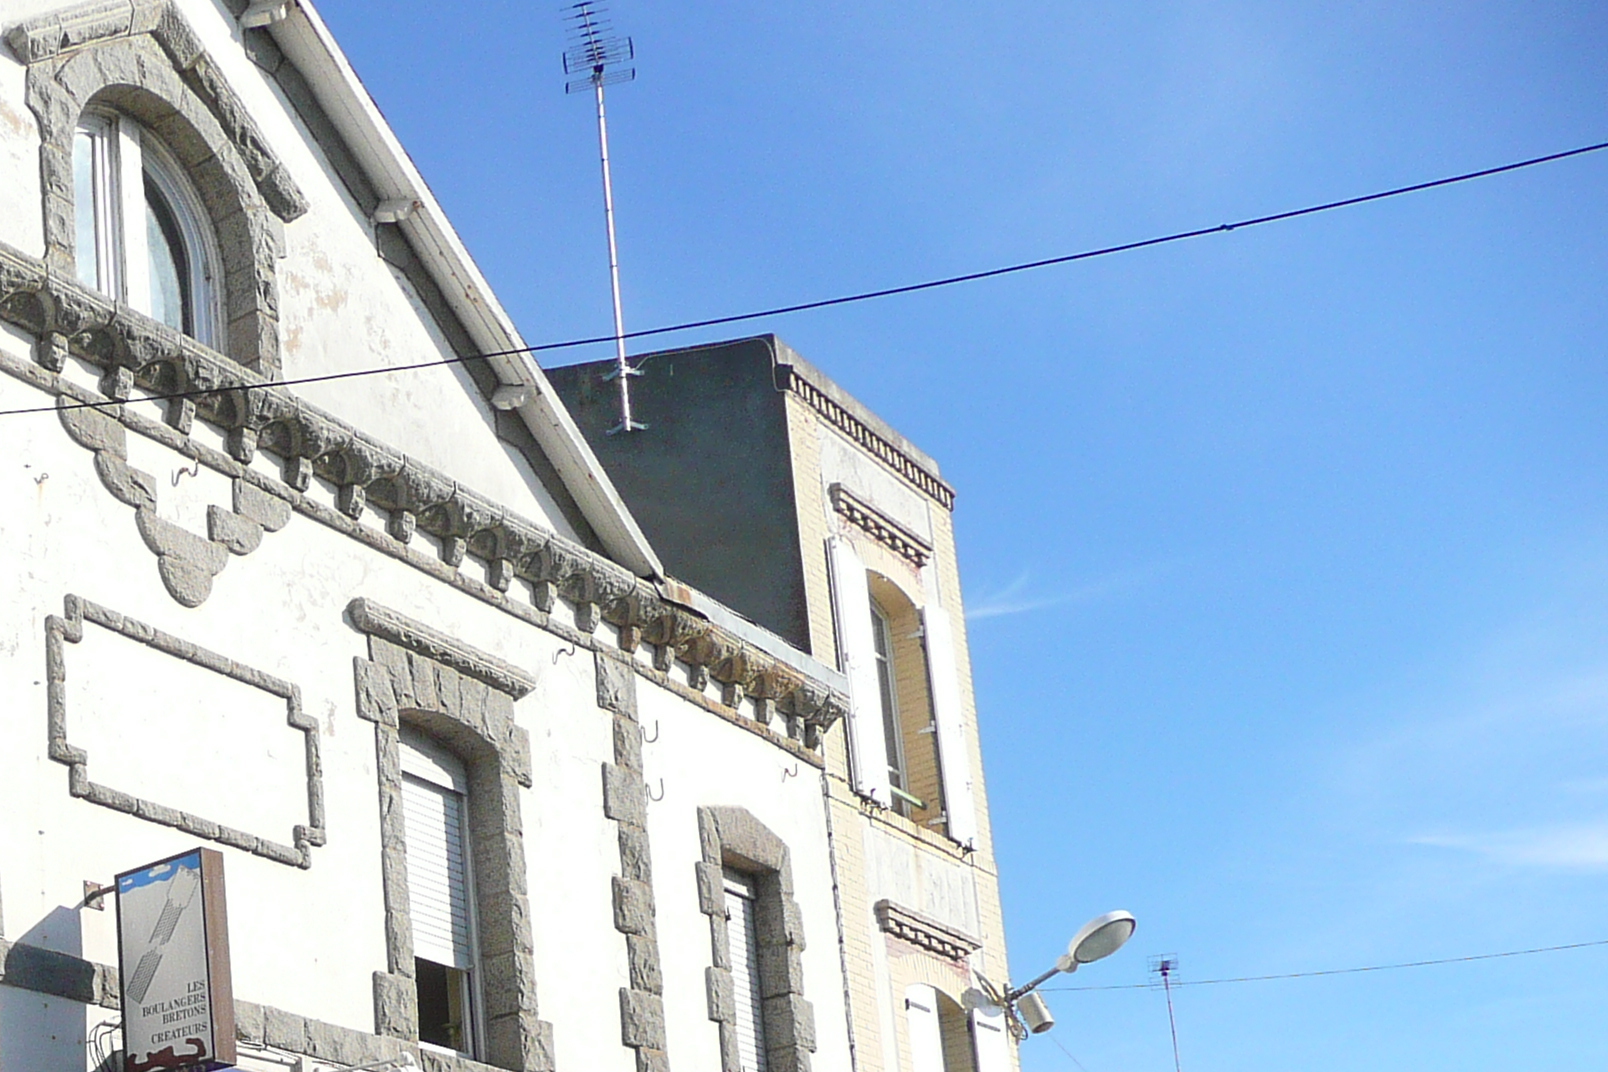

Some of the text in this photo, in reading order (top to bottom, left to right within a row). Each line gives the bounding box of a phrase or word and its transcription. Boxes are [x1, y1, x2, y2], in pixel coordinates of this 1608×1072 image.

[187, 979, 205, 994] LES
[142, 992, 206, 1017] BOULANGERS
[162, 1004, 206, 1024] BRETONS
[151, 1021, 208, 1044] CREATEURS
